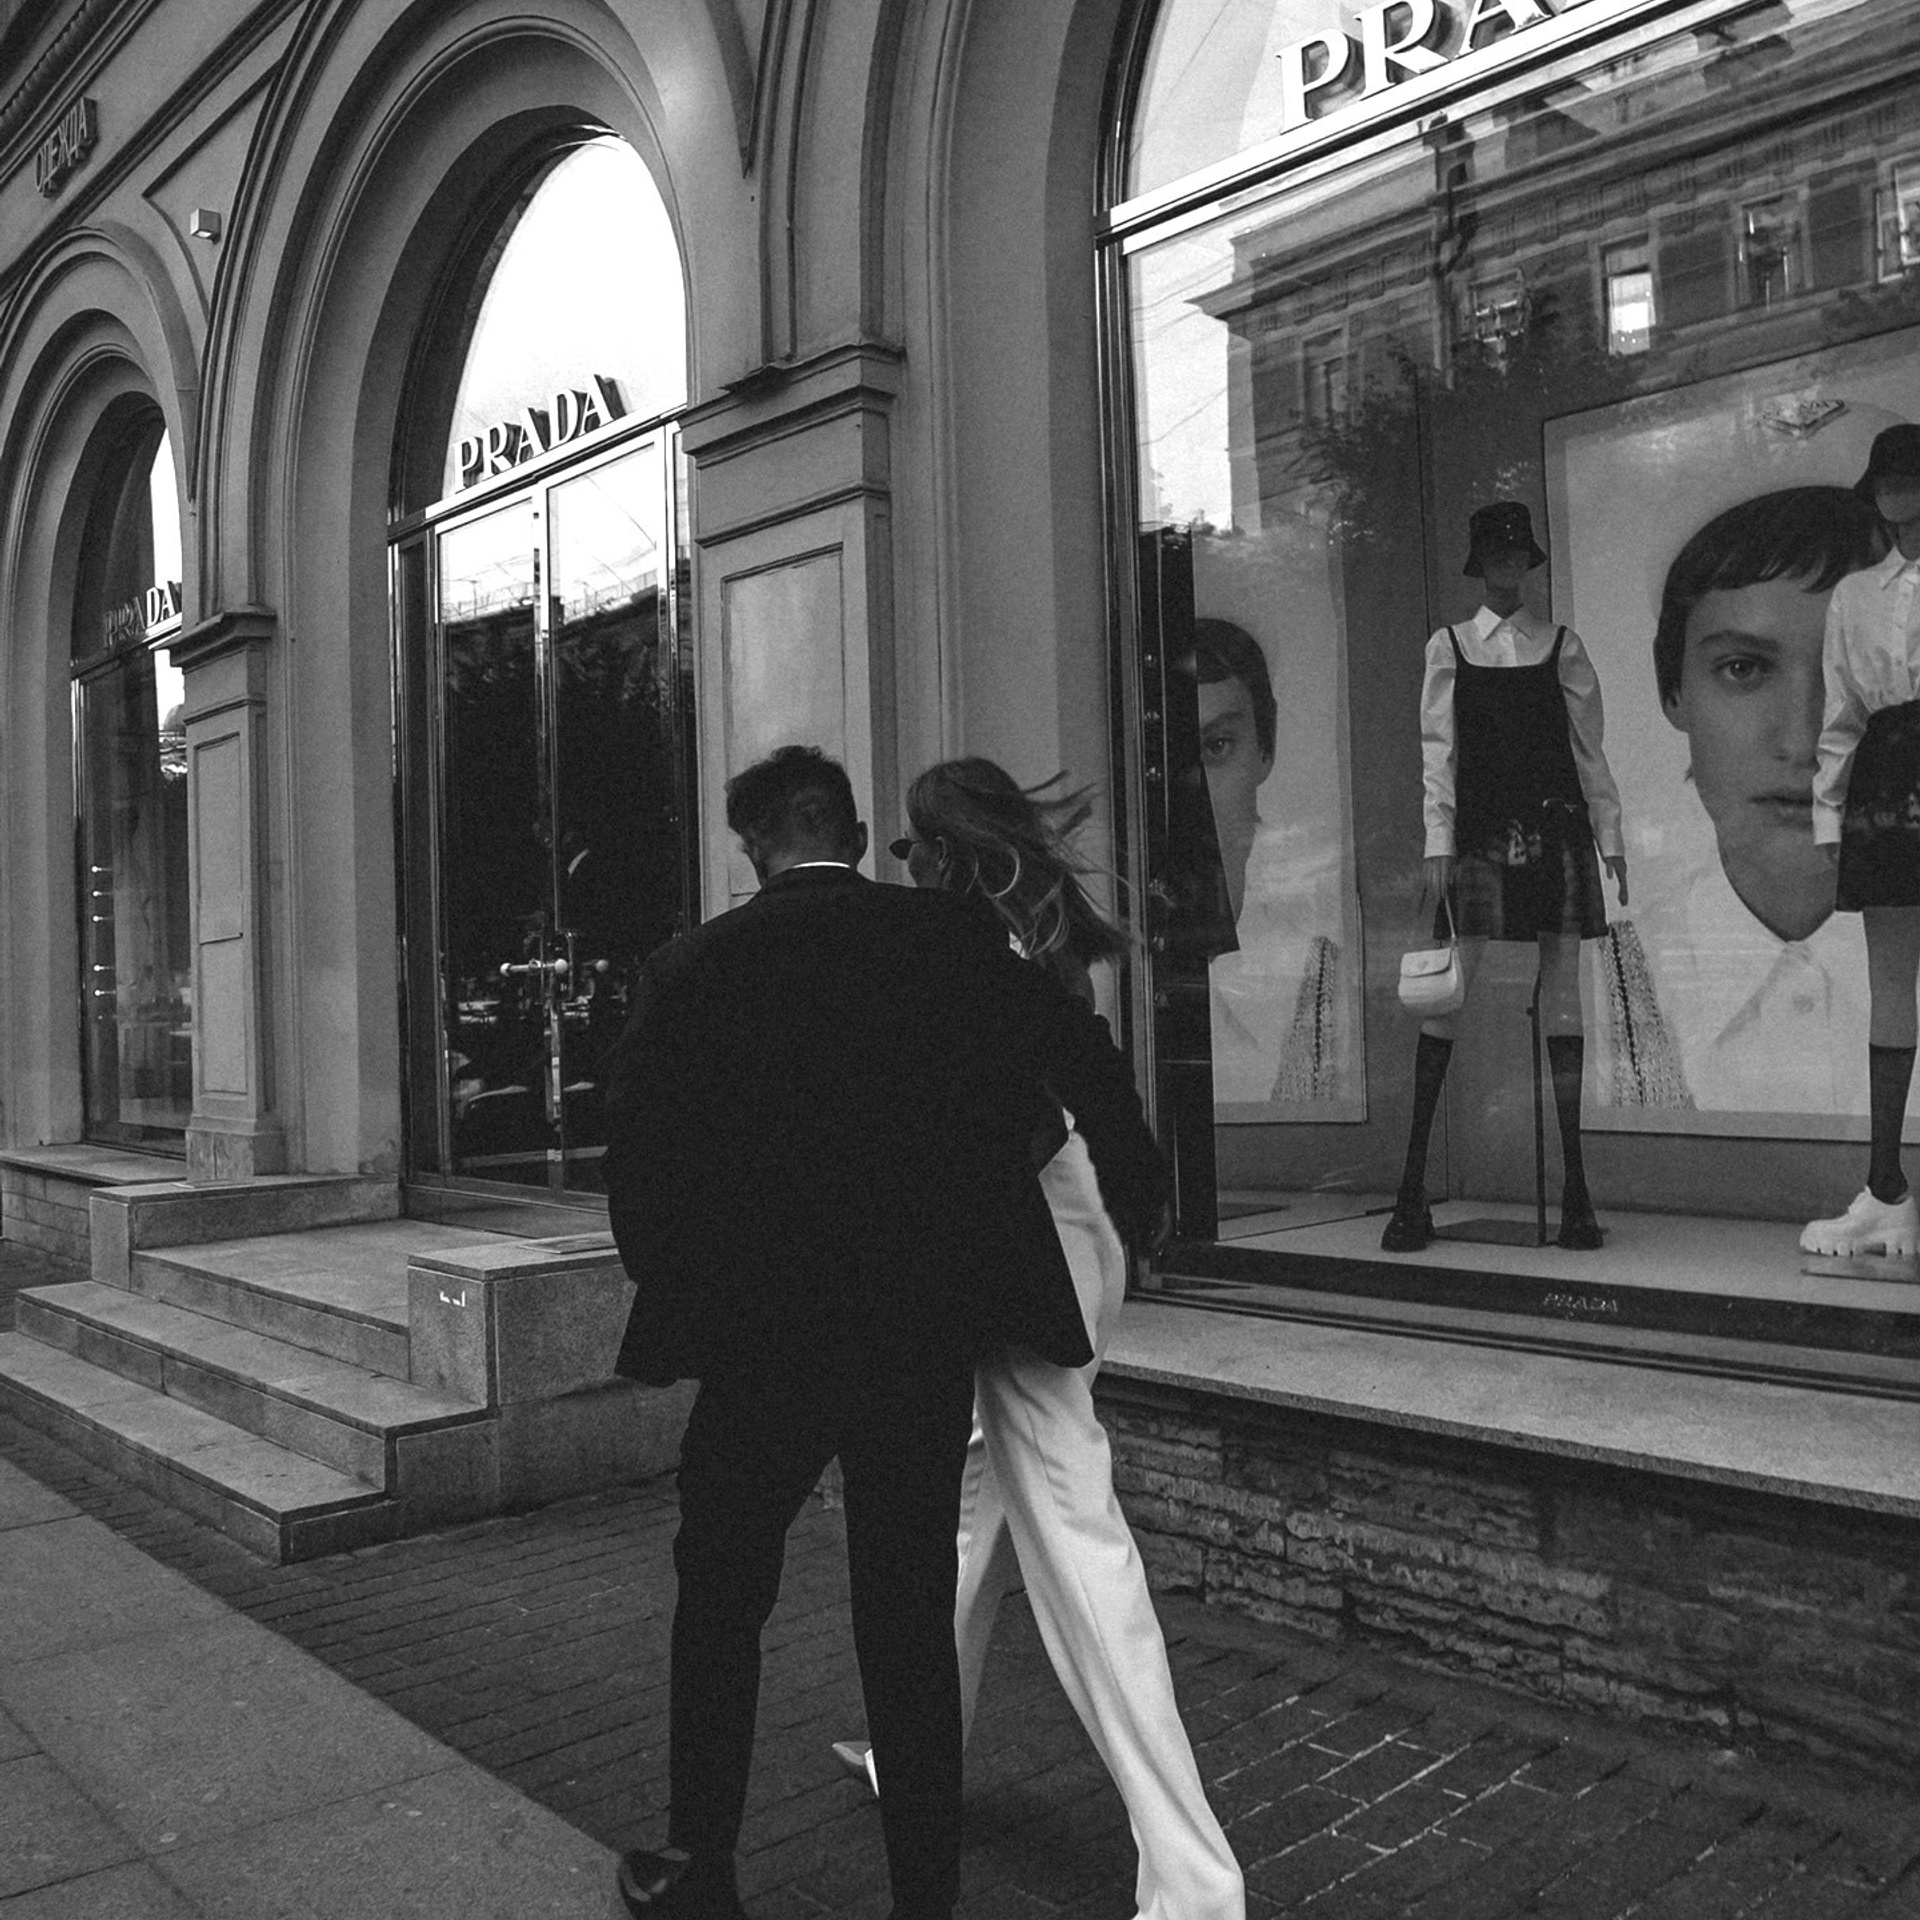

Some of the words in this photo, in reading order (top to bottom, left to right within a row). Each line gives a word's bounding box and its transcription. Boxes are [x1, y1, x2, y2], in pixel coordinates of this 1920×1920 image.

[1276, 0, 1590, 135] PRA
[36, 97, 88, 192] ОДЕЖДА
[451, 372, 617, 493] PRADA
[104, 581, 177, 647] PRADA
